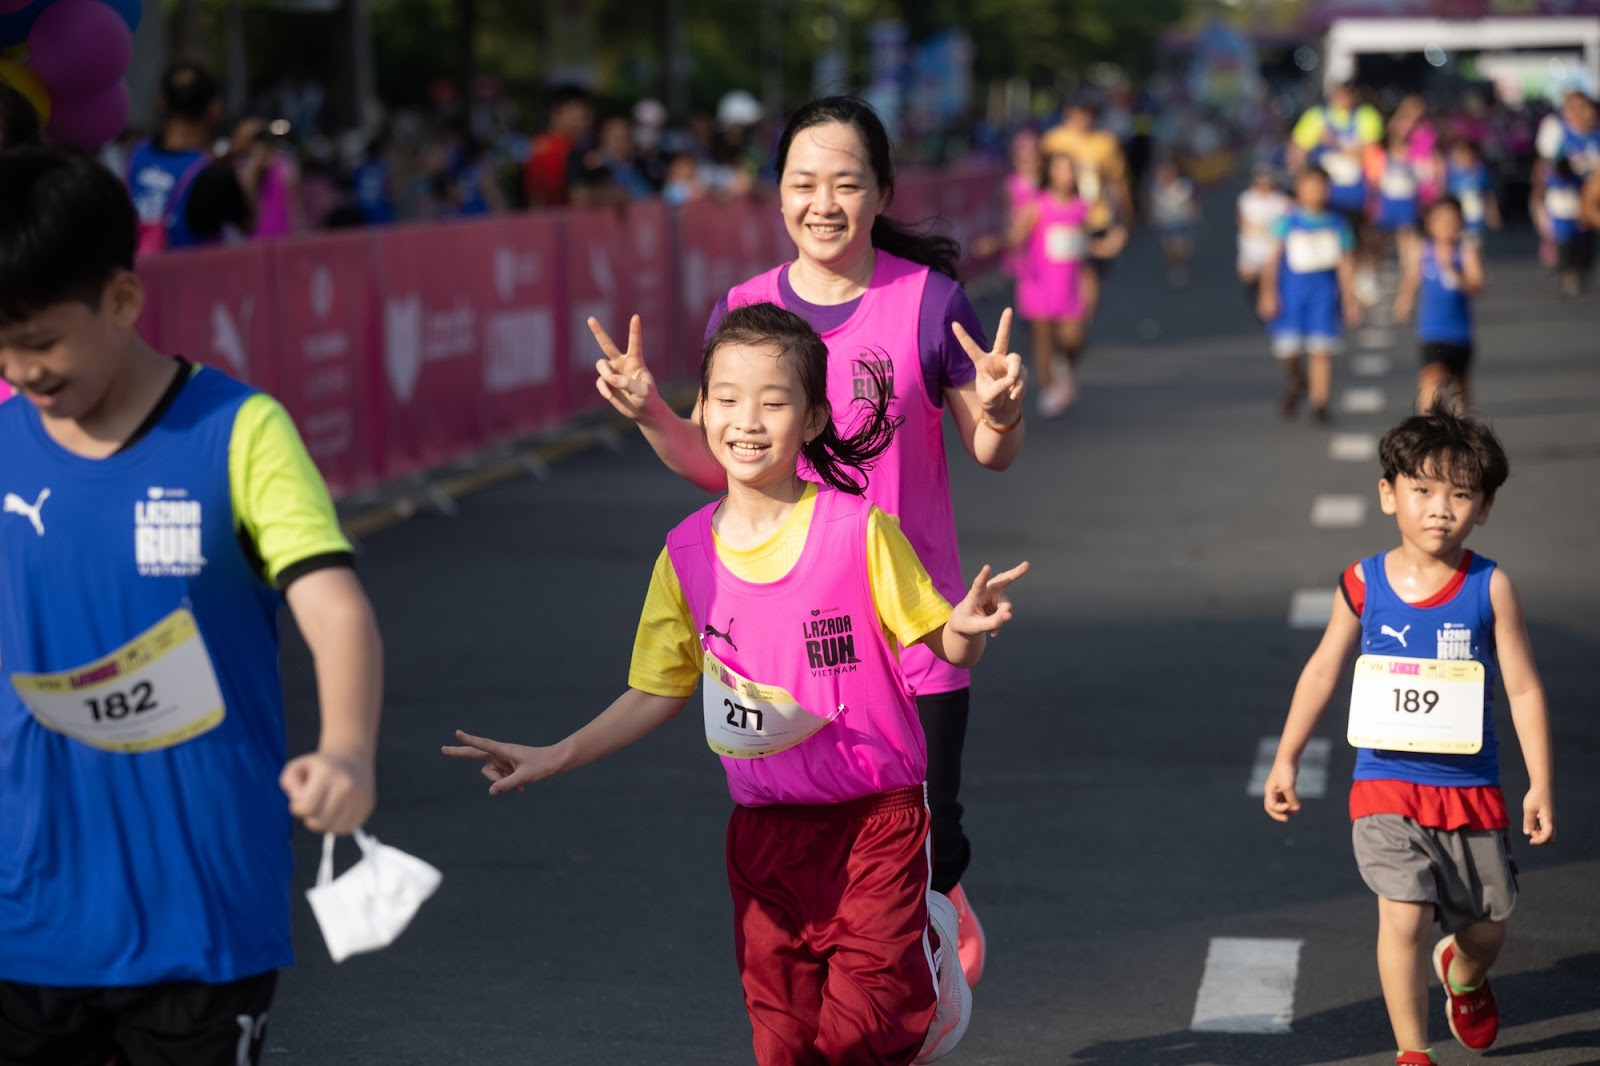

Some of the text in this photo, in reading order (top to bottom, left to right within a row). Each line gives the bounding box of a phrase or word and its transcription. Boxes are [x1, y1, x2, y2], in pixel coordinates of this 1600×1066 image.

[803, 615, 852, 639] LAZADA
[806, 635, 861, 669] RUN
[811, 665, 857, 677] VIETNAM
[85, 681, 157, 722] 182
[724, 698, 763, 731] 277
[1392, 688, 1439, 714] 189
